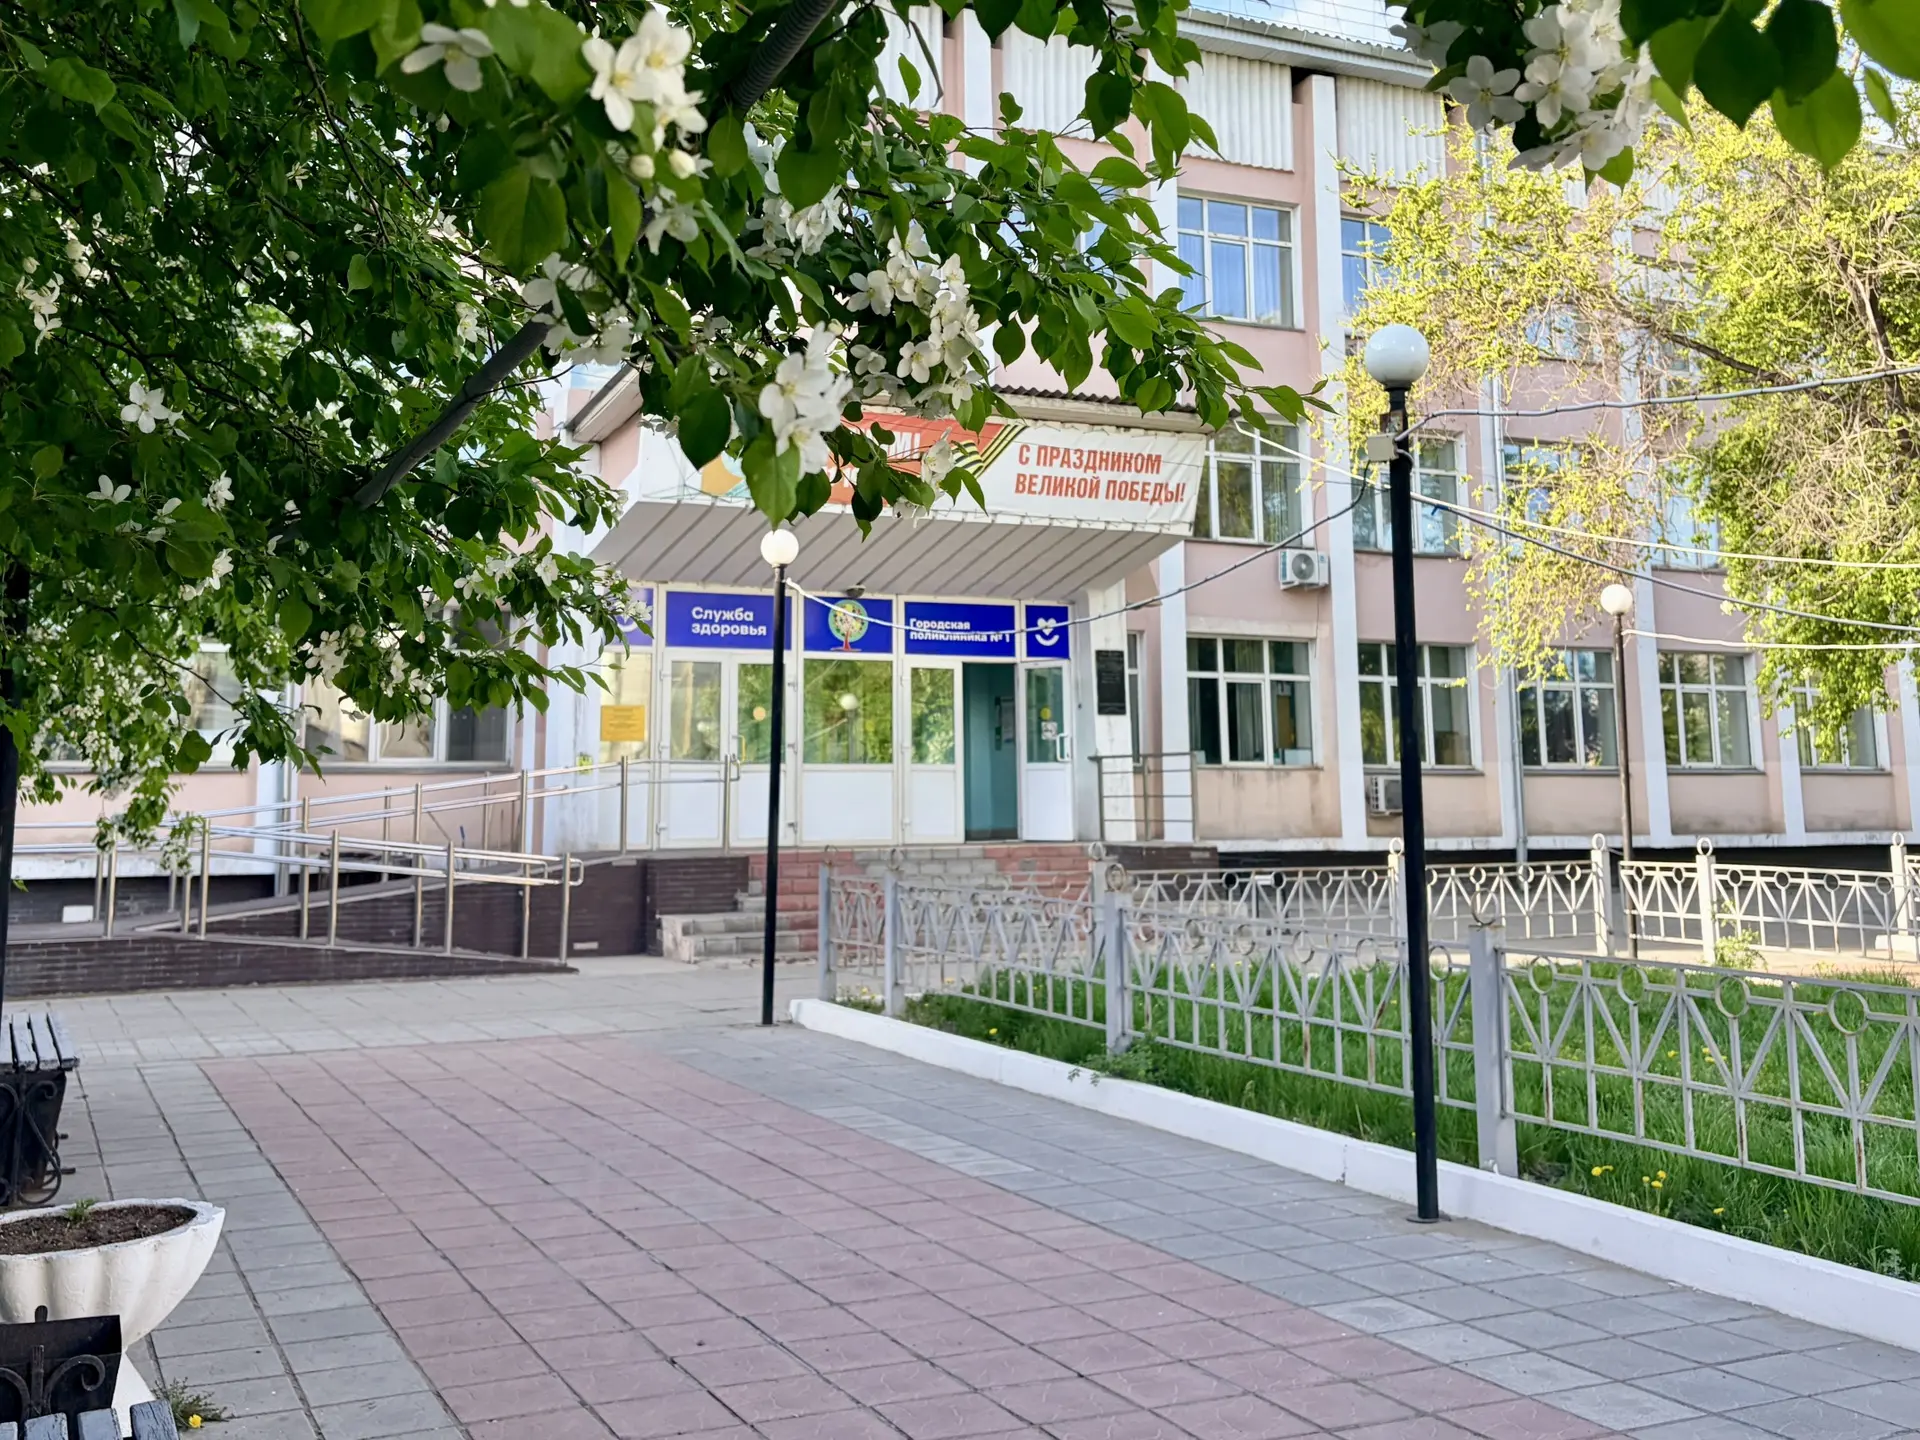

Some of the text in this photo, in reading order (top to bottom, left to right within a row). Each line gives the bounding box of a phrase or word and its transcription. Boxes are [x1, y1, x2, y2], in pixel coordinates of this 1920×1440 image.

[1018, 443, 1162, 474] С ПРАЗДНИКОМ
[1014, 473, 1186, 505] ВЕЛИКОЙ ПОБЕДЫ!
[691, 606, 754, 623] Служба
[691, 622, 767, 637] здоровья
[909, 618, 971, 631] Городская
